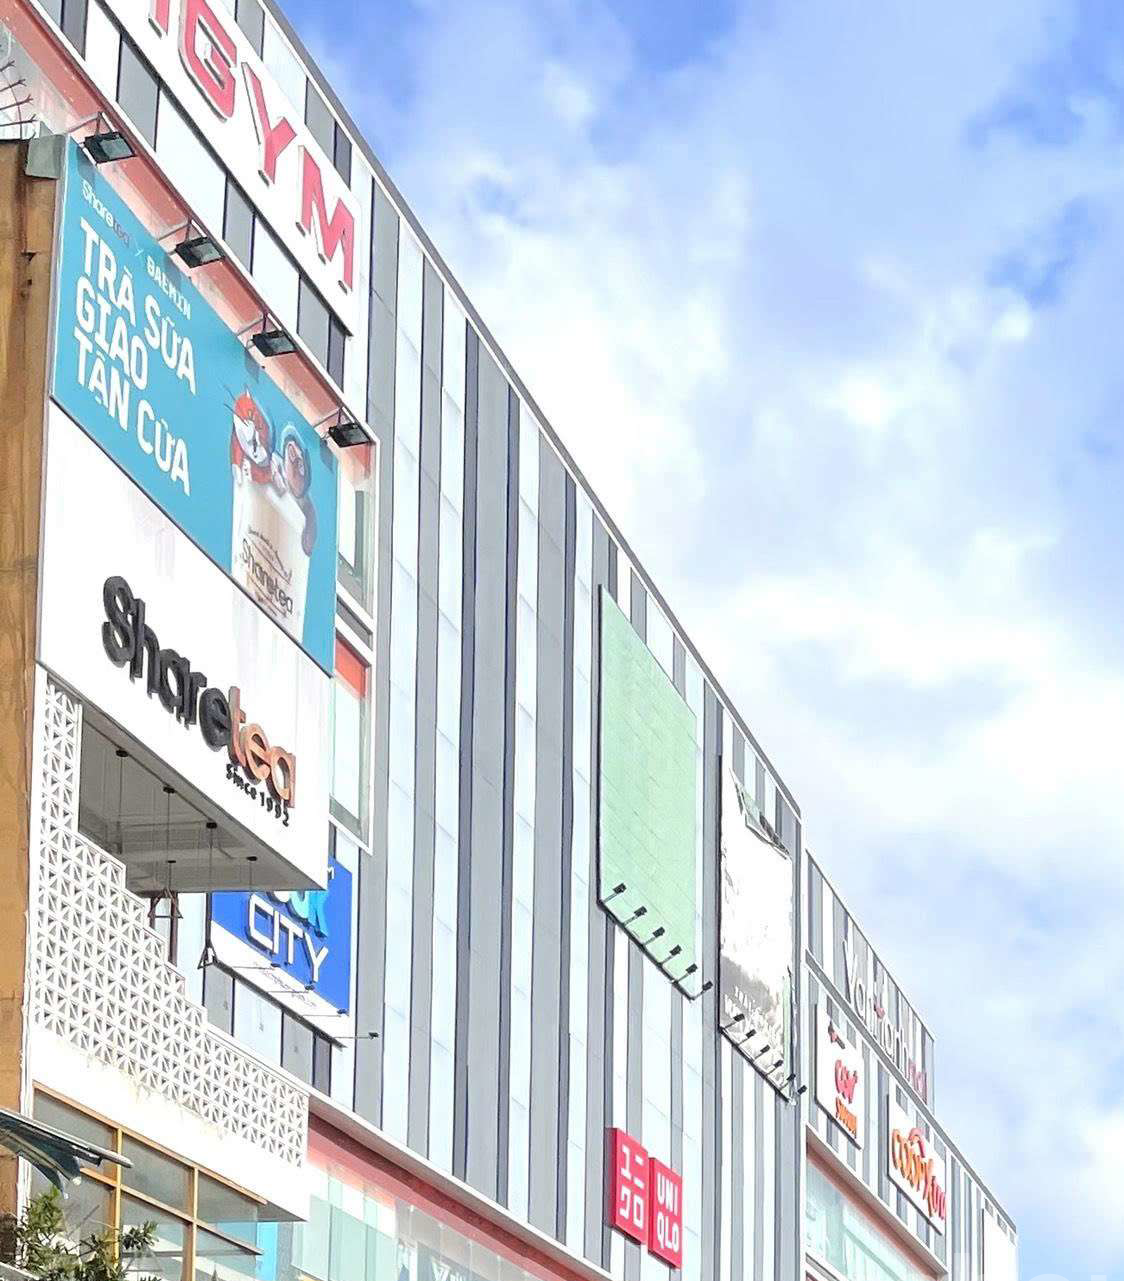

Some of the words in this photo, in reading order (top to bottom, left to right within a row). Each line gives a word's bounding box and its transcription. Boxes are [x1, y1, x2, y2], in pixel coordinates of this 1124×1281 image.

[75, 275, 149, 390] GIAO
[249, 893, 329, 983] CITY
[656, 1172, 679, 1217] UNI
